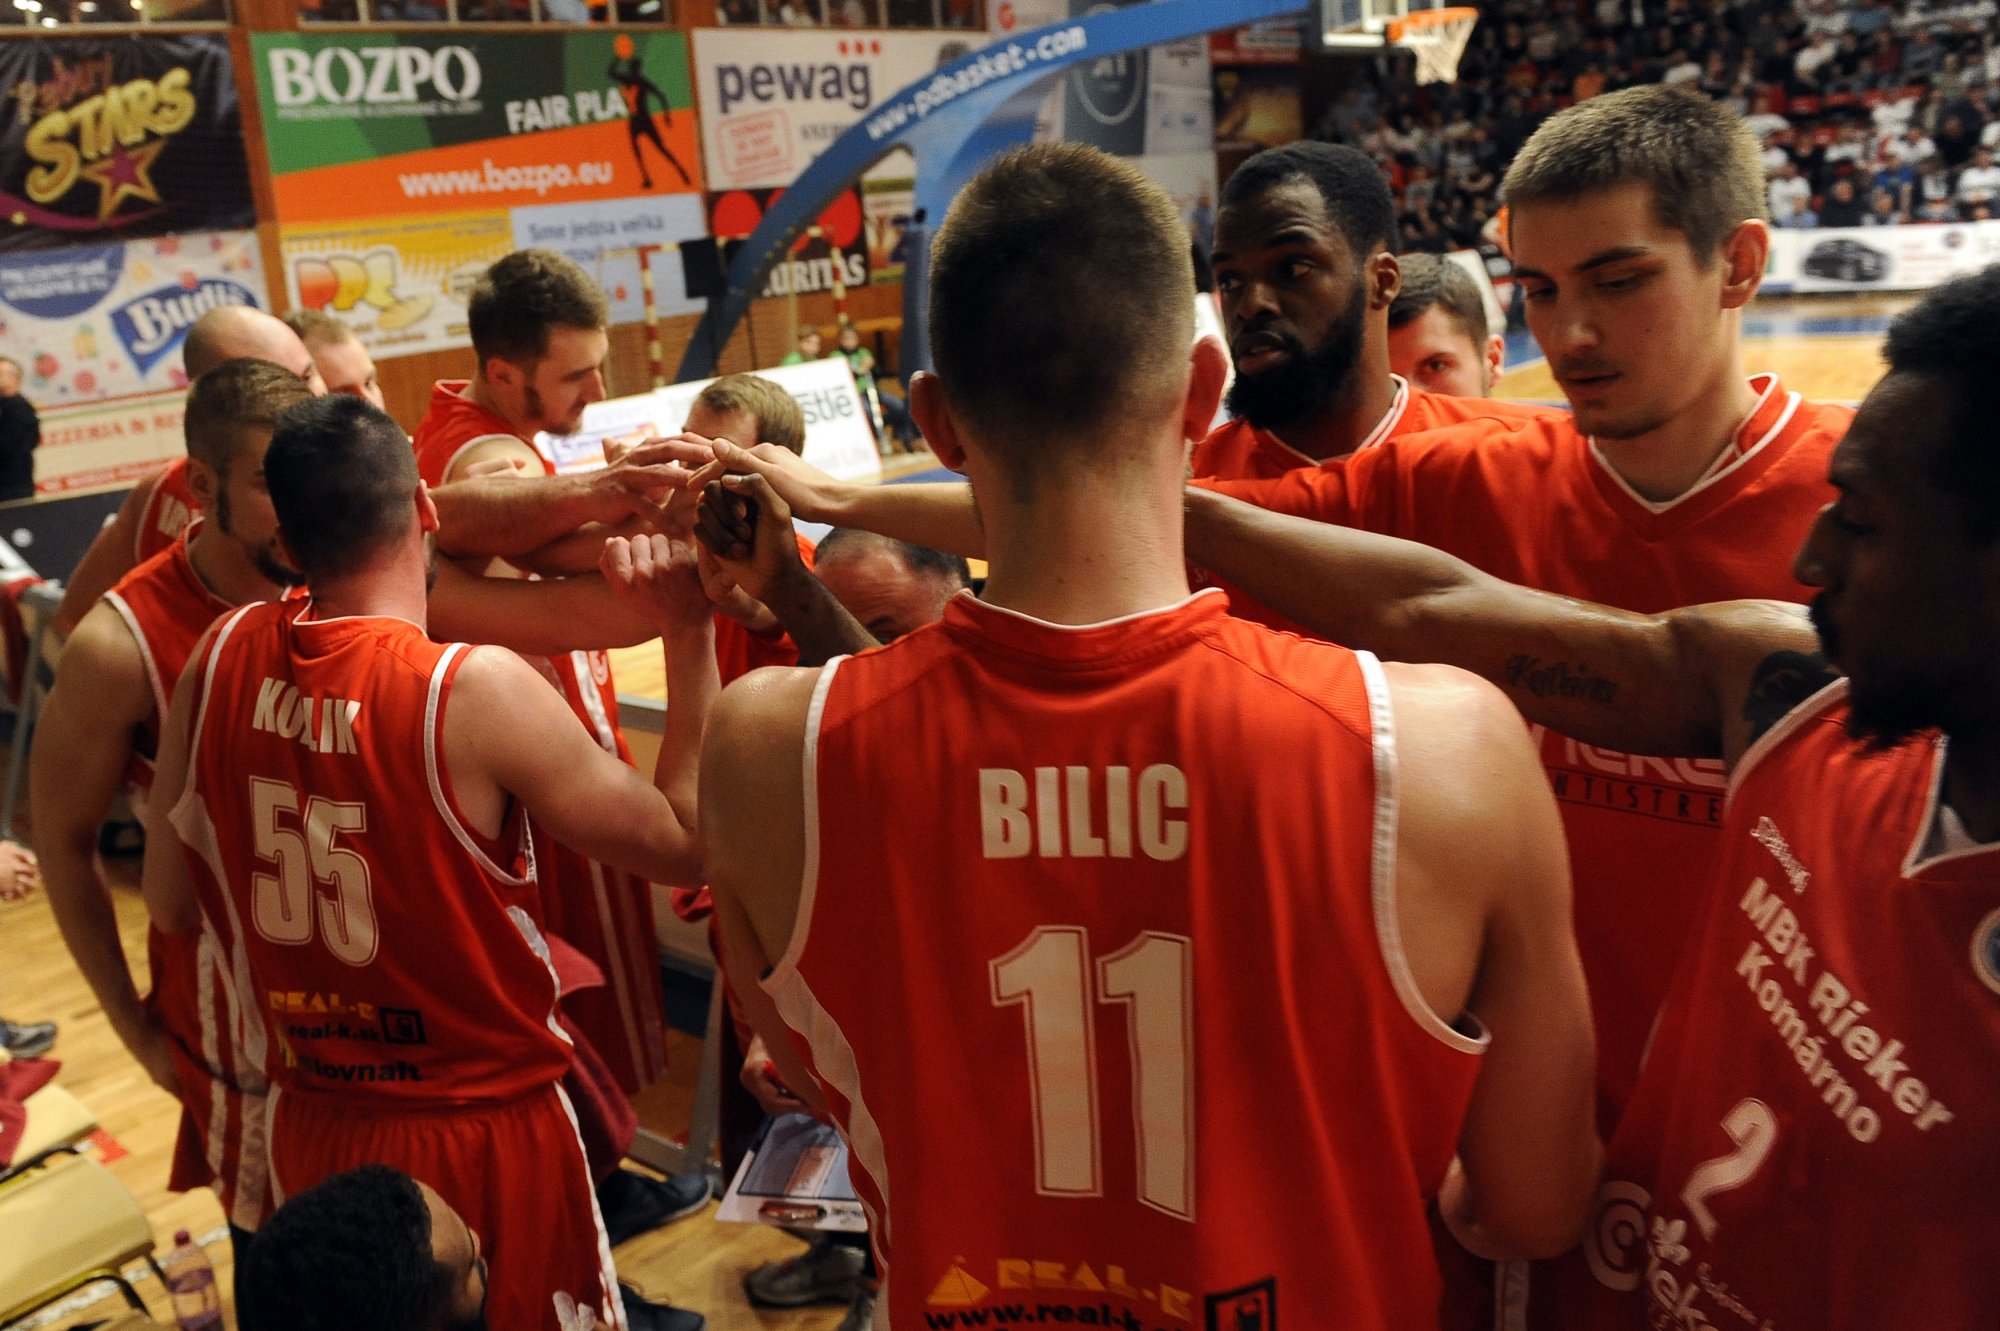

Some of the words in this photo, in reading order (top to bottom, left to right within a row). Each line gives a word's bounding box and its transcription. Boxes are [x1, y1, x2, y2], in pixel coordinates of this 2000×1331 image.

[268, 45, 481, 105] BOZPO
[505, 94, 571, 134] FAIR
[716, 63, 872, 114] pewag
[25, 66, 196, 204] STARS
[399, 158, 614, 197] www.bozpo.eu
[762, 253, 866, 297] URITAS
[249, 775, 379, 967] 55
[979, 763, 1190, 861] BILIC
[1735, 940, 1882, 1143] Komárno
[1739, 877, 1816, 987] MBK
[1808, 971, 1956, 1131] Rieker
[988, 925, 1196, 1223] 11
[1677, 1097, 1779, 1243] 2
